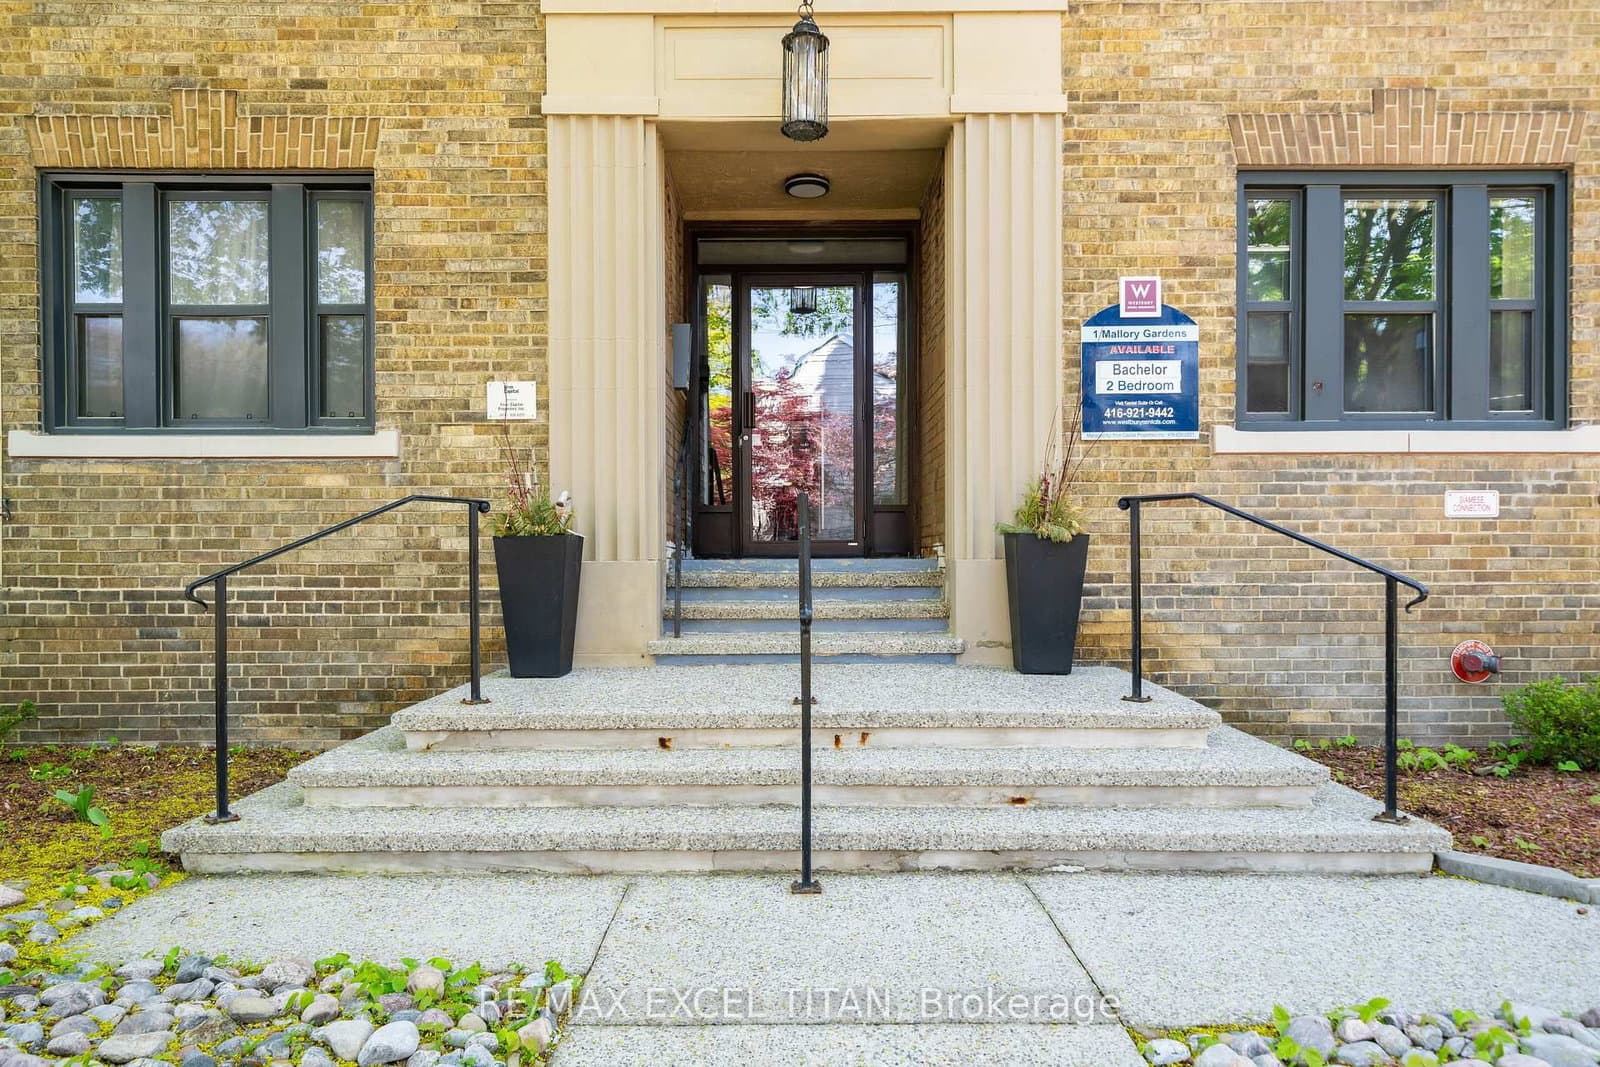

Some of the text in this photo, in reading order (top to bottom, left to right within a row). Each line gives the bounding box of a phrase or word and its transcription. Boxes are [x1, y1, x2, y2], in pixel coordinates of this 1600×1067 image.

[1130, 283, 1151, 298] W
[1102, 330, 1140, 340] Mallory
[1143, 329, 1188, 338] Gardens
[1109, 345, 1176, 354] AVAILABLE
[1113, 364, 1168, 375] Bachelor
[1106, 380, 1174, 391] 2 Bedroom
[1104, 407, 1174, 418] 416-921-9442
